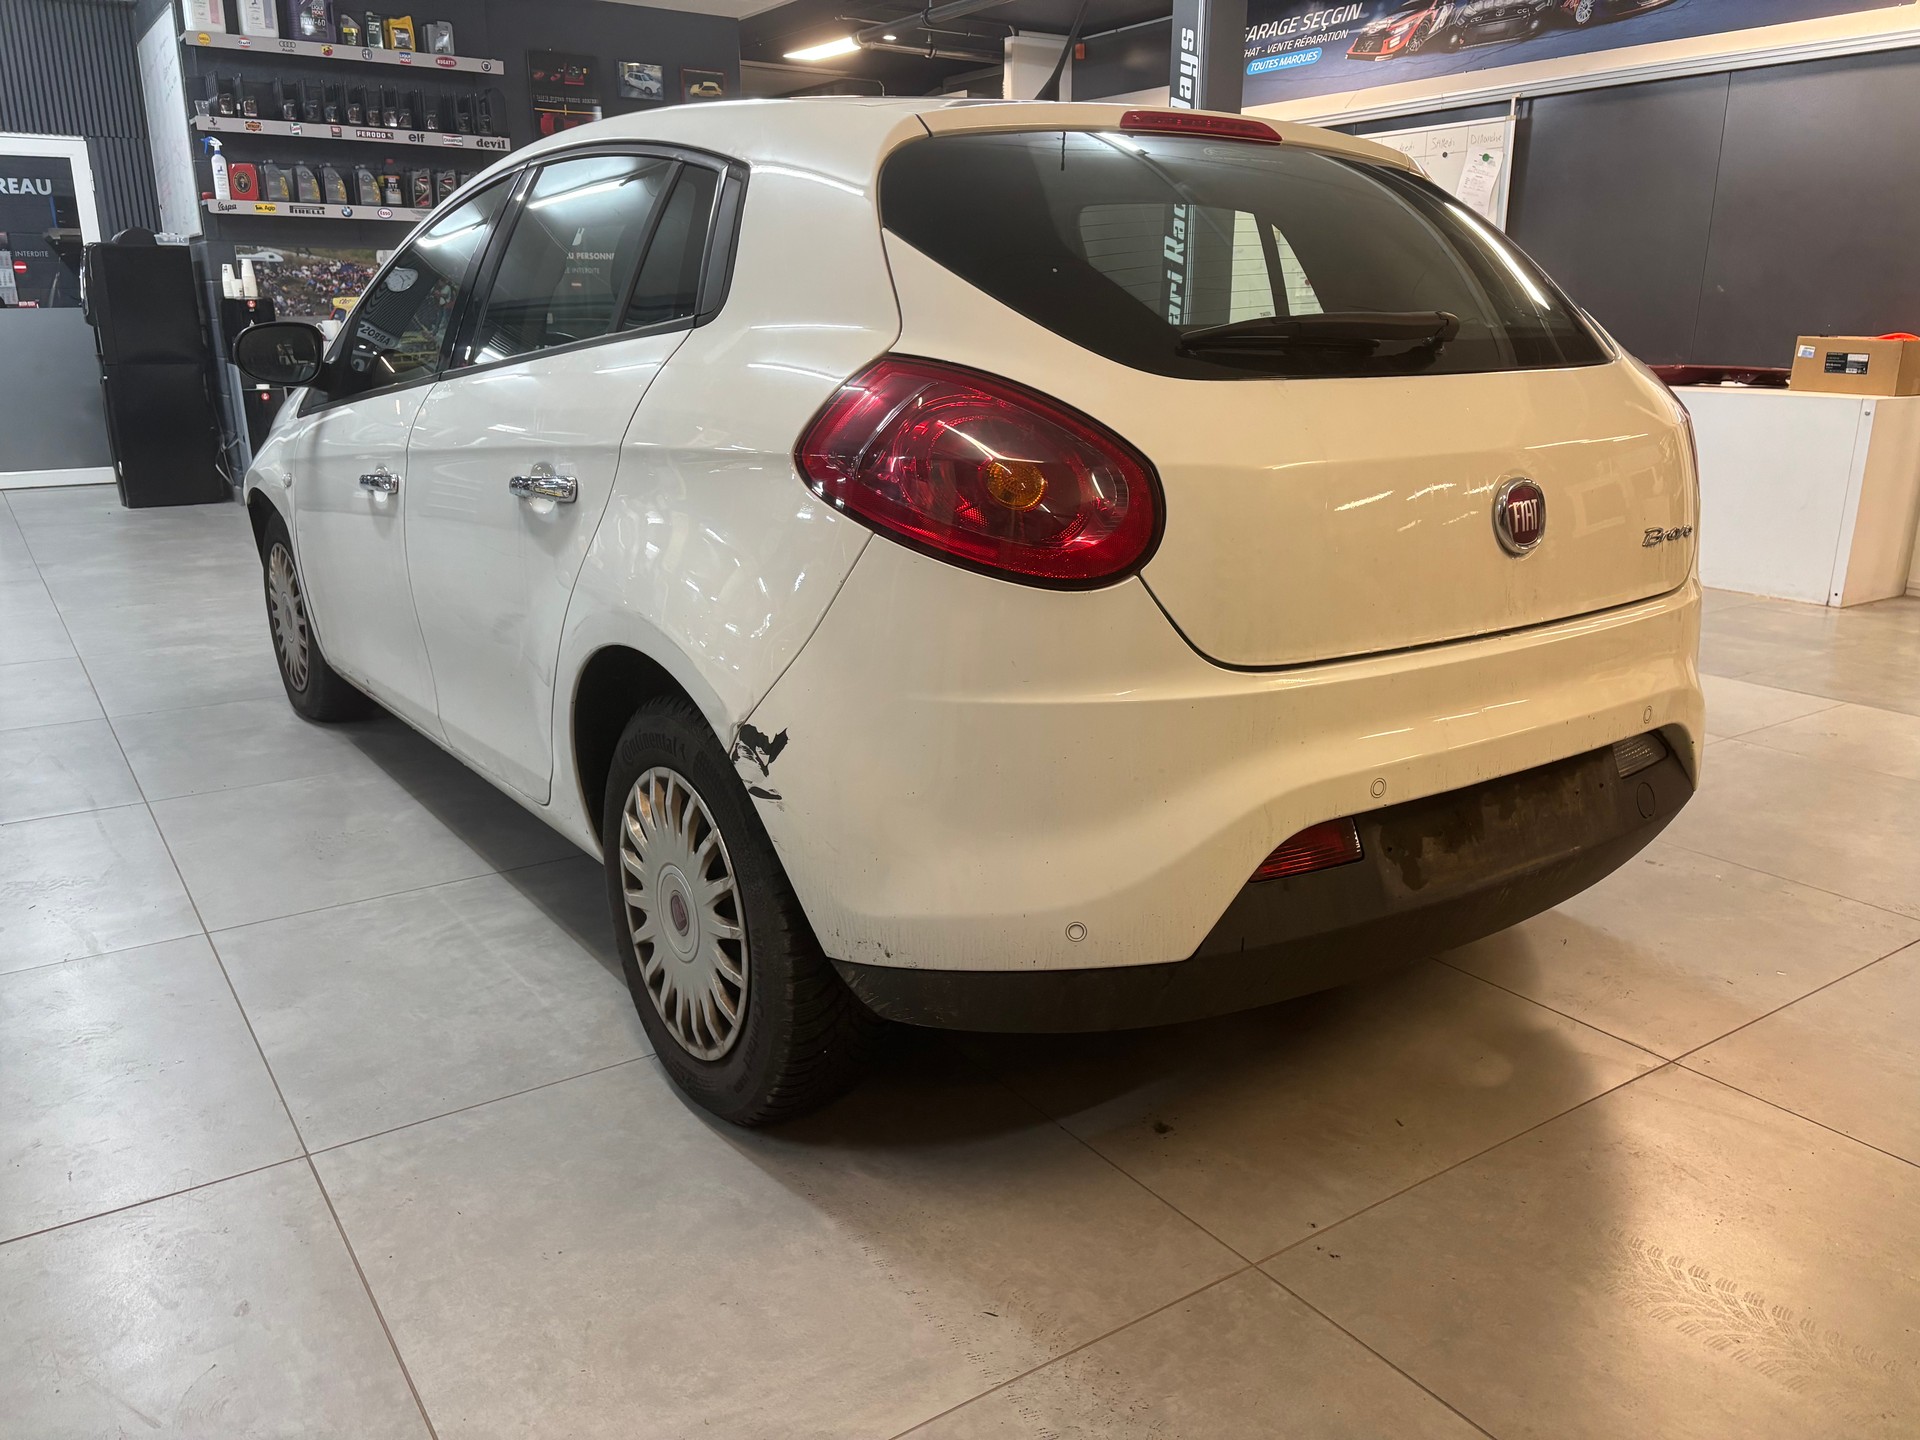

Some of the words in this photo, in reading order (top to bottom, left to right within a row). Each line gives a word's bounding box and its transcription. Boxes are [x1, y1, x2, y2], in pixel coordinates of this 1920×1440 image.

[1300, 2, 1363, 33] SEÇGIN
[1267, 40, 1295, 53] VENTE
[1294, 29, 1349, 49] RÉPARATION
[1250, 56, 1279, 72] TOUTES
[1279, 51, 1318, 66] MARQUES
[356, 130, 387, 139] FERODO
[408, 133, 425, 143] elf
[443, 137, 463, 145] CHAMPION
[476, 138, 506, 149] devil
[217, 201, 237, 212] Vespa
[289, 205, 325, 215] PIRELLI
[15, 250, 49, 258] INTERDITE
[1509, 498, 1538, 533] FIAT
[1642, 524, 1693, 547] Bravo
[622, 729, 677, 763] Continental
